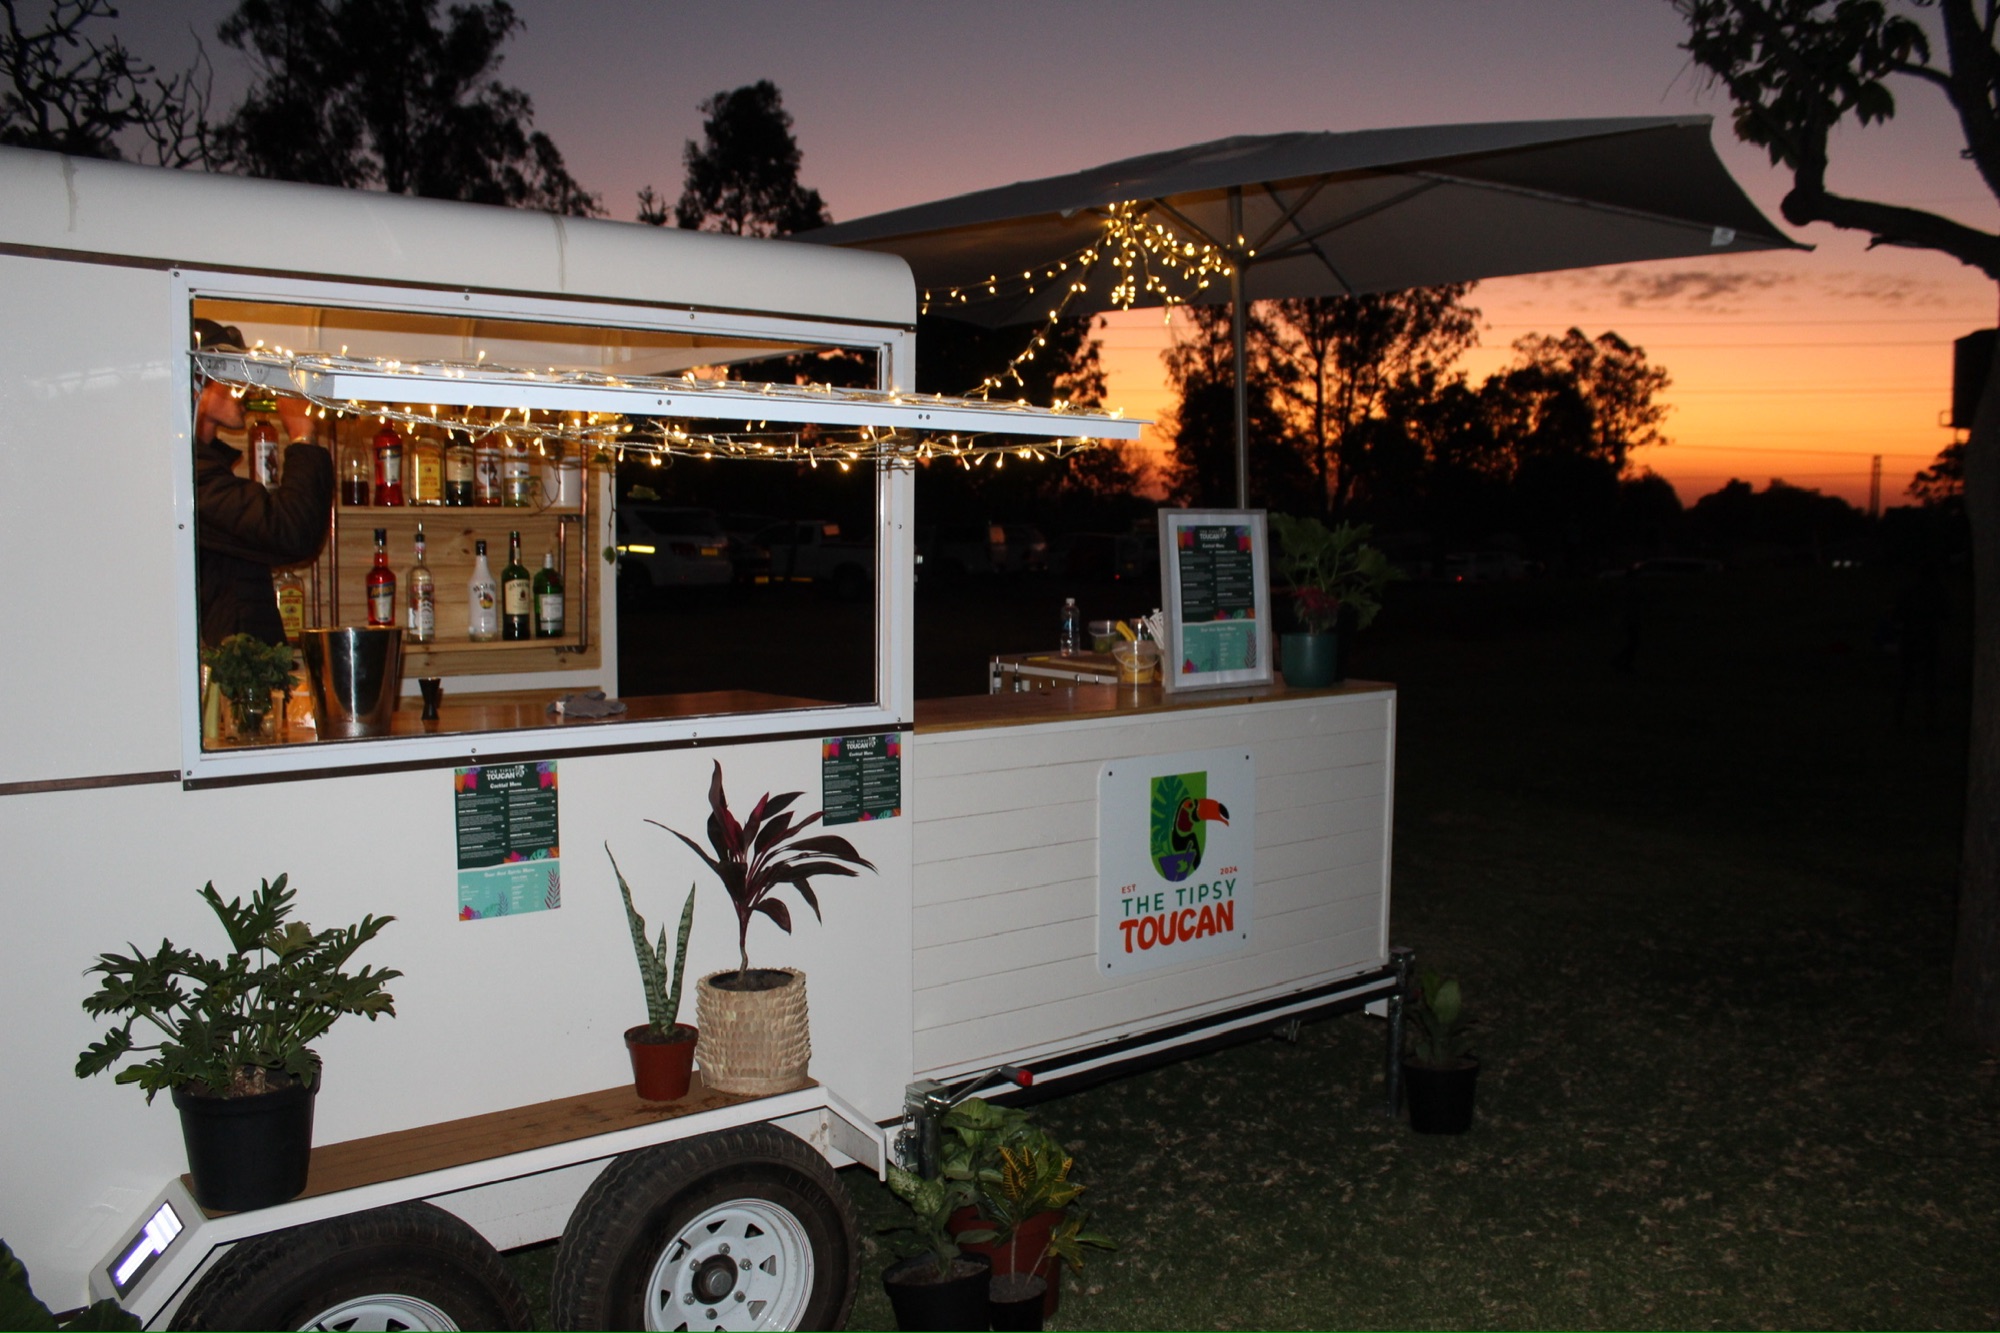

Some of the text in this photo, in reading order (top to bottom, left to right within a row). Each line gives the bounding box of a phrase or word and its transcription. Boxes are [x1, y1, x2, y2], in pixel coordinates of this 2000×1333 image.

[486, 772, 515, 780] TOUCAN
[1121, 866, 1237, 894] EST 2024
[1122, 878, 1236, 917] THE TIPSY
[1119, 900, 1234, 954] TOUCAN
